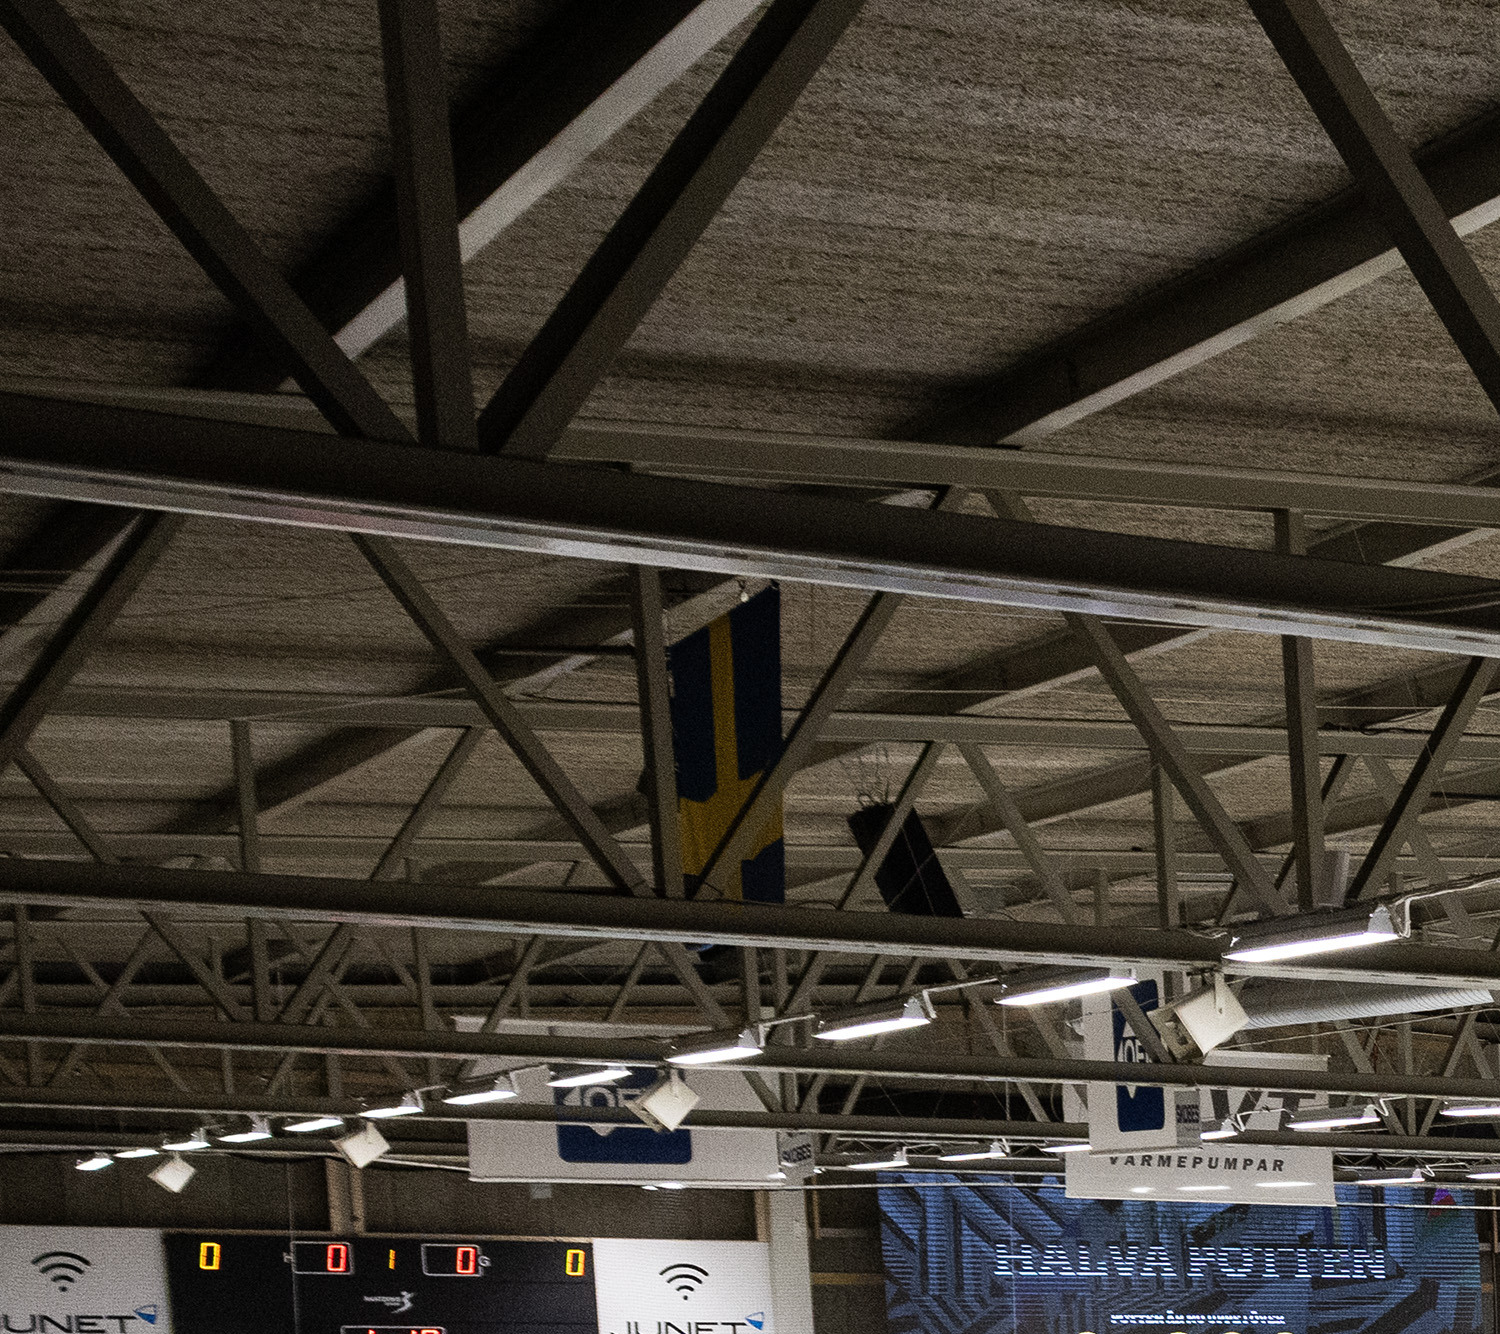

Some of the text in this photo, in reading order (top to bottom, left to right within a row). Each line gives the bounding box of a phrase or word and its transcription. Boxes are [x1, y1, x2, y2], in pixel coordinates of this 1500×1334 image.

[1110, 1156, 1285, 1172] VÄRMEPUMPAR
[327, 1244, 347, 1272] 0
[456, 1246, 476, 1275] 0
[994, 1243, 1387, 1280] HALVA POTTEN
